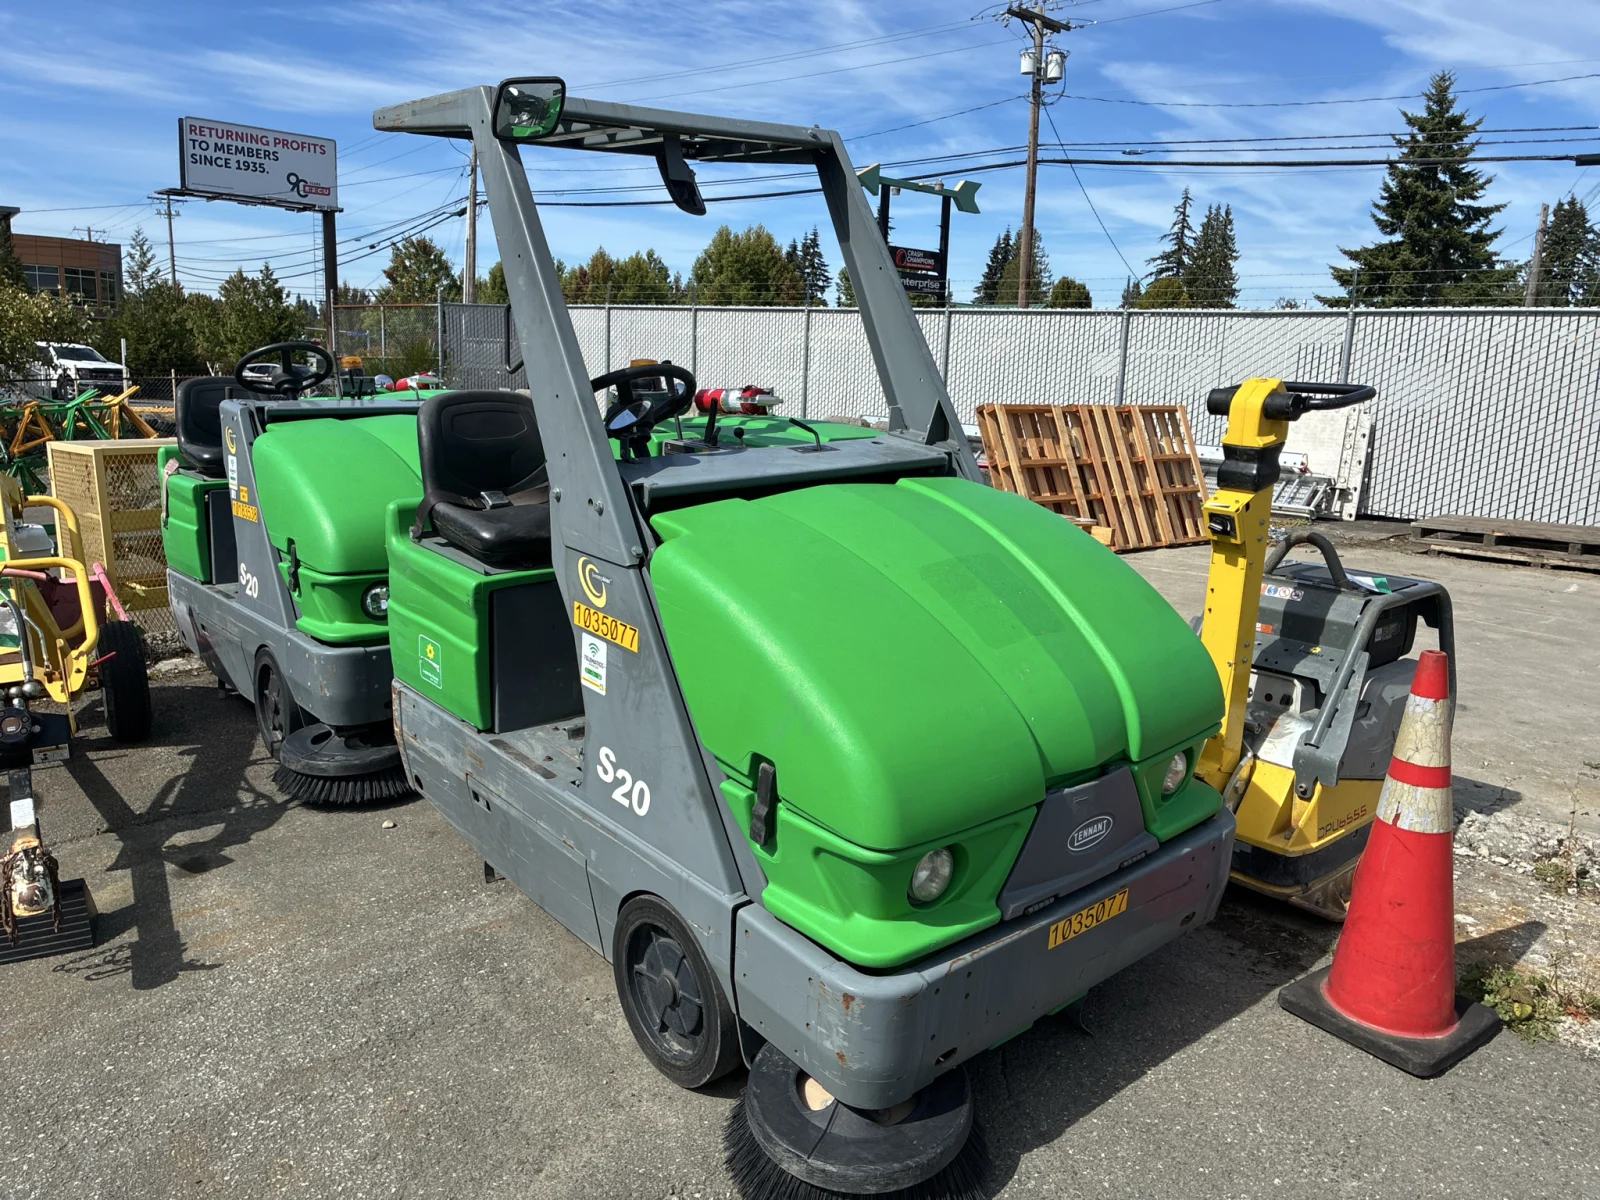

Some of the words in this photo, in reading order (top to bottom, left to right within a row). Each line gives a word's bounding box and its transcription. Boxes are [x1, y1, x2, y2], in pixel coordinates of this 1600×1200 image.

[189, 124, 270, 146] RETURNING
[274, 136, 326, 155] PROFITS
[189, 138, 209, 151] TO
[214, 142, 279, 161] MEMBERS
[190, 153, 232, 169] SINCE
[235, 160, 269, 174] 1935.
[906, 256, 935, 265] CHAMPIONS
[900, 277, 940, 289] nterprise
[240, 562, 259, 599] S20
[575, 604, 638, 648] 1035077
[596, 746, 651, 817] S20
[1074, 820, 1108, 846] TENNANT
[1051, 890, 1128, 946] 1035077
